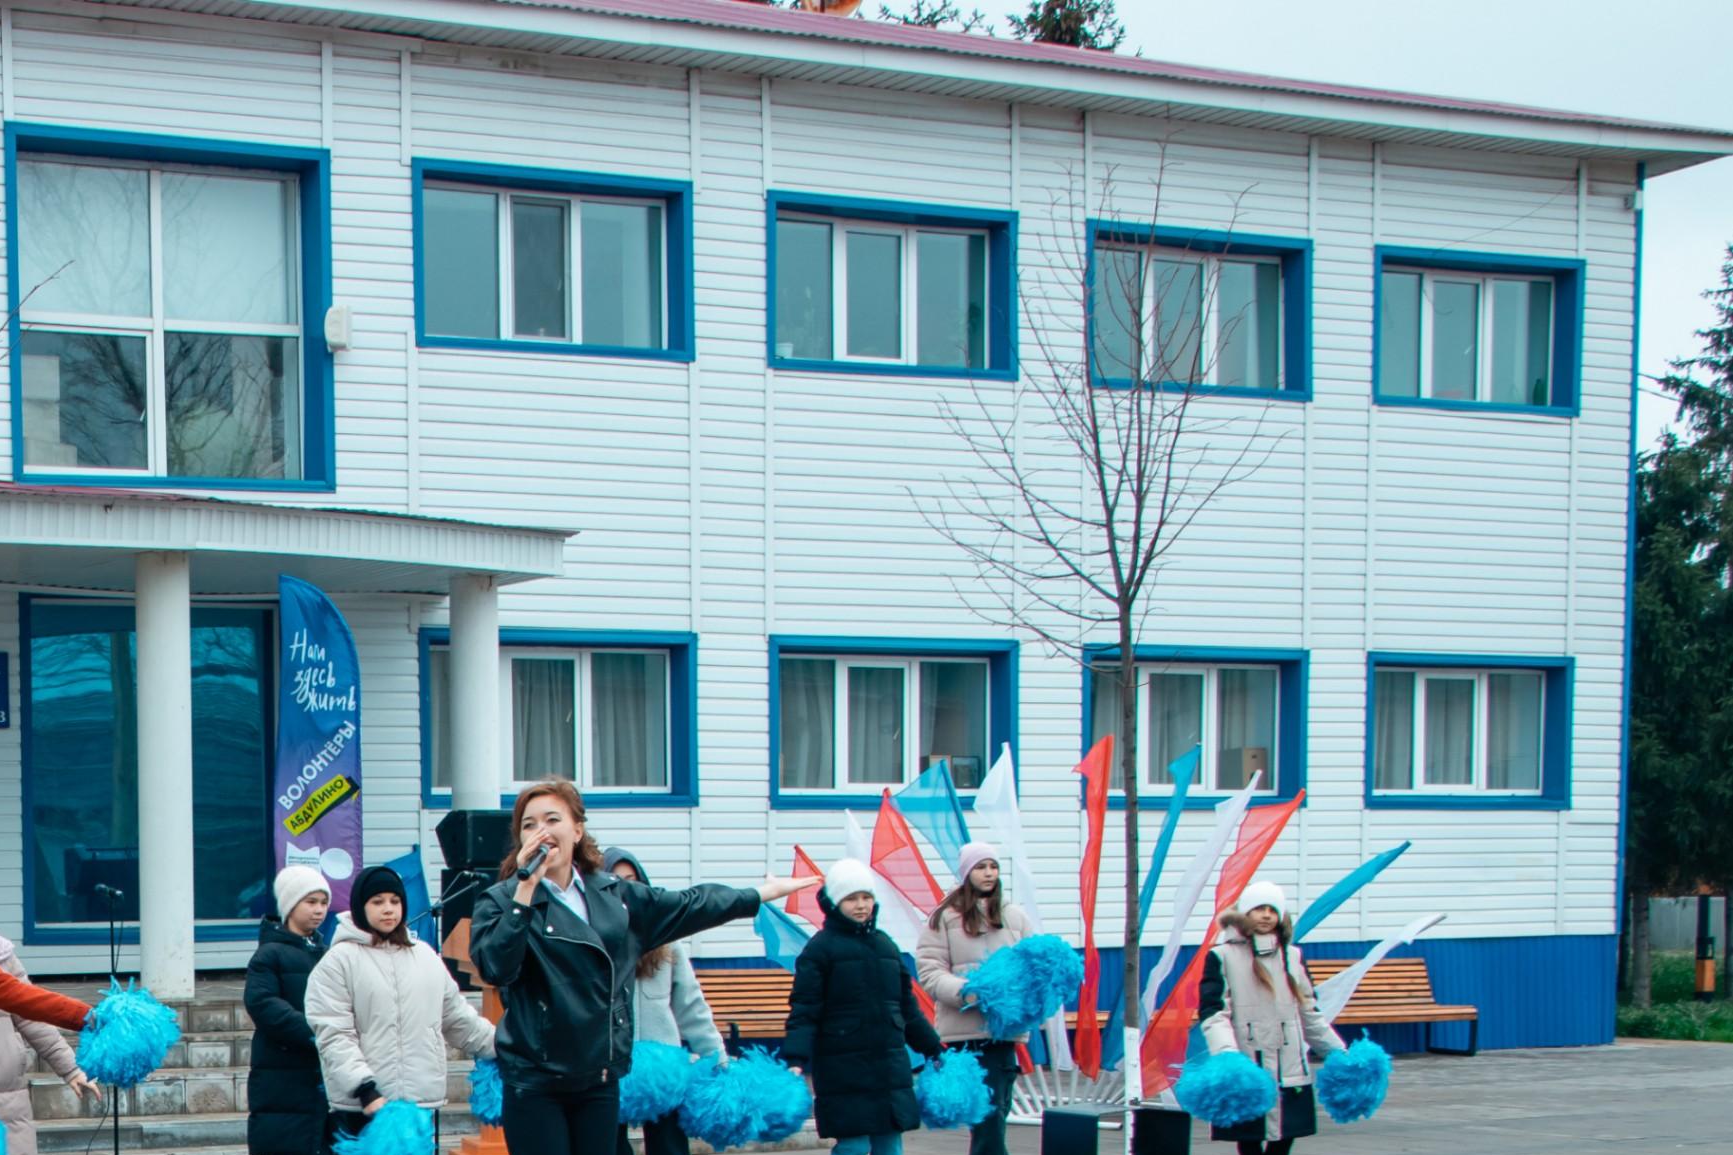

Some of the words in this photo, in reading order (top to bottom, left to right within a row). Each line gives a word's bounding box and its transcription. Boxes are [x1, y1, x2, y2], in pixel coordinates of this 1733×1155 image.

[289, 627, 326, 664] Нам
[290, 661, 336, 704] здесь
[303, 686, 356, 712] жить
[278, 720, 356, 810] ВОЛОНТЁРЫ
[289, 778, 345, 831] АБДУЛИНО
